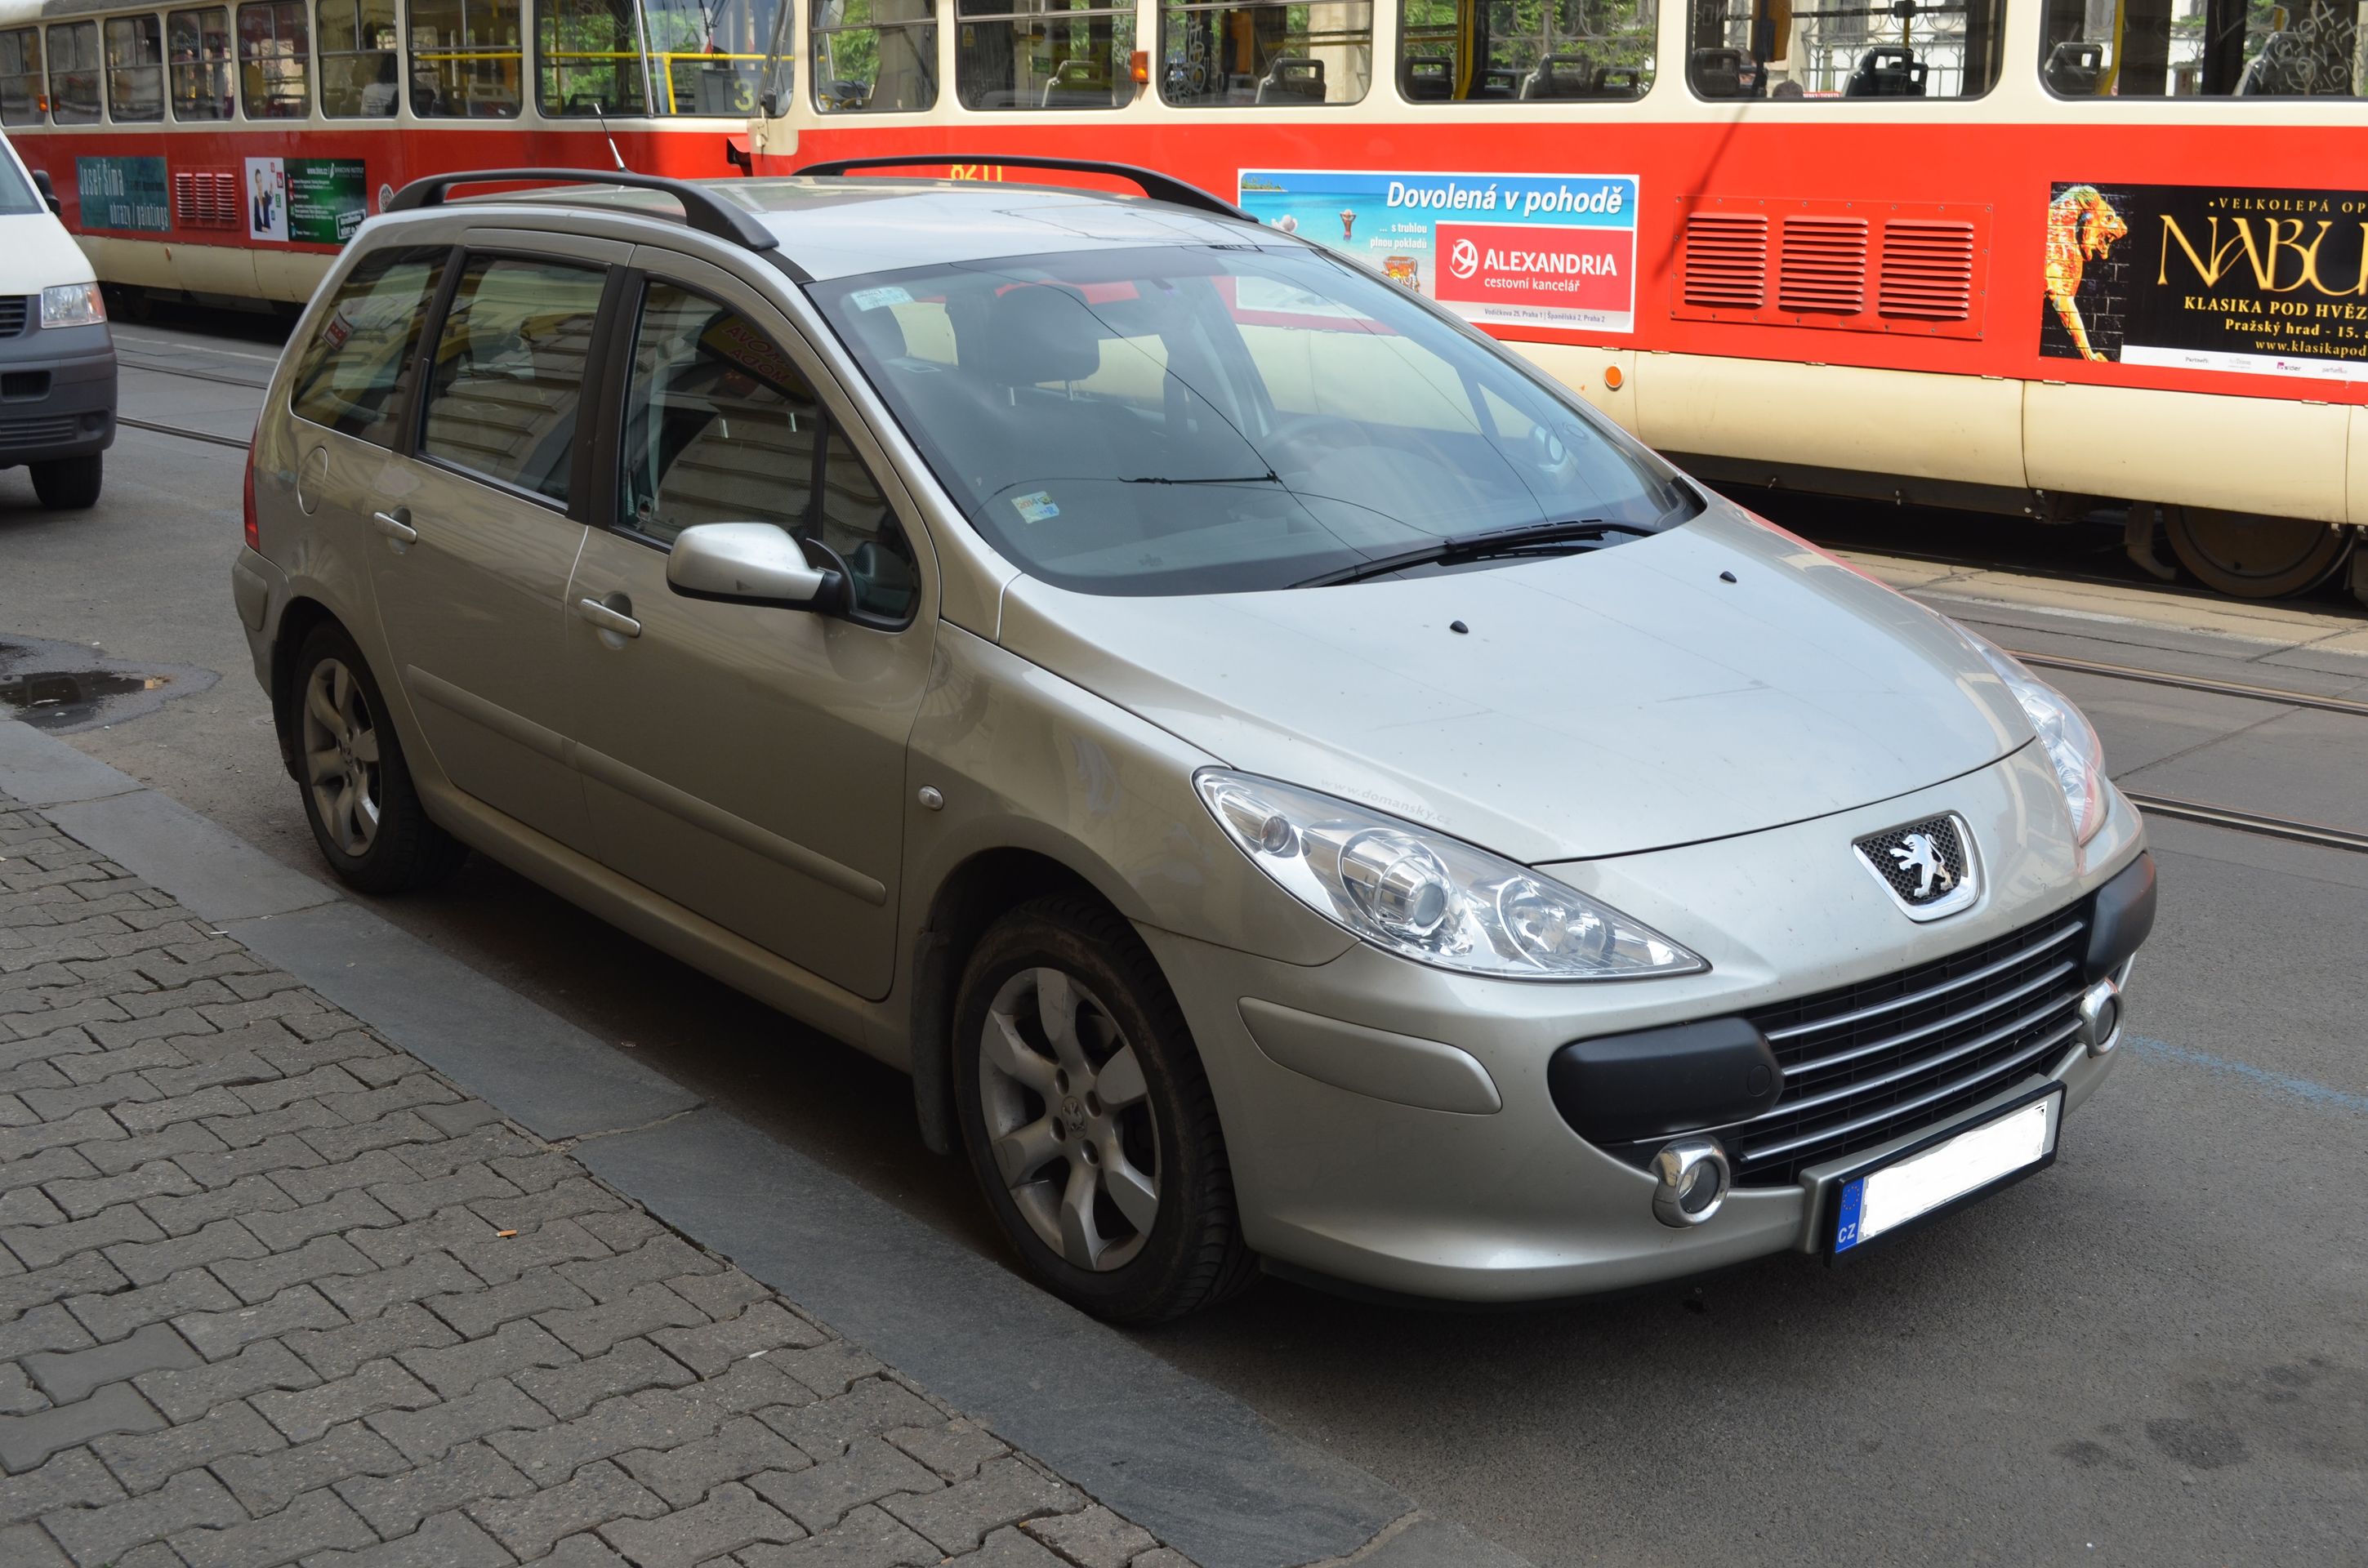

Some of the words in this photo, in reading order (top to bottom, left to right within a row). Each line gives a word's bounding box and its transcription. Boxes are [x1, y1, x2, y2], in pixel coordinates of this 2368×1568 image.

[734, 78, 753, 111] 3
[1387, 181, 1497, 211] Dovolená
[1505, 189, 1519, 211] v
[1523, 185, 1624, 218] pohodě
[2219, 197, 2330, 212] VELKOLEPÁ
[2342, 201, 2366, 214] OP
[1391, 224, 1397, 233] s
[1398, 222, 1427, 234] truhlou
[1370, 237, 1393, 249] plnou
[1394, 238, 1427, 250] pokladů
[1483, 248, 1617, 276] ALEXANDRIA
[1484, 277, 1529, 290] cestovní
[1532, 278, 1581, 292] kancelář
[2184, 296, 2262, 314] KLASIKA
[2269, 301, 2308, 316] POD
[2315, 303, 2367, 320] HVĚZ
[2225, 318, 2281, 336] Pražský
[2285, 322, 2320, 336] hrad
[2338, 326, 2359, 338] 15.
[2255, 341, 2367, 359] www.klasikapod
[1321, 778, 1452, 825] www.domansky.cz
[1838, 1223, 1856, 1244] CZ
